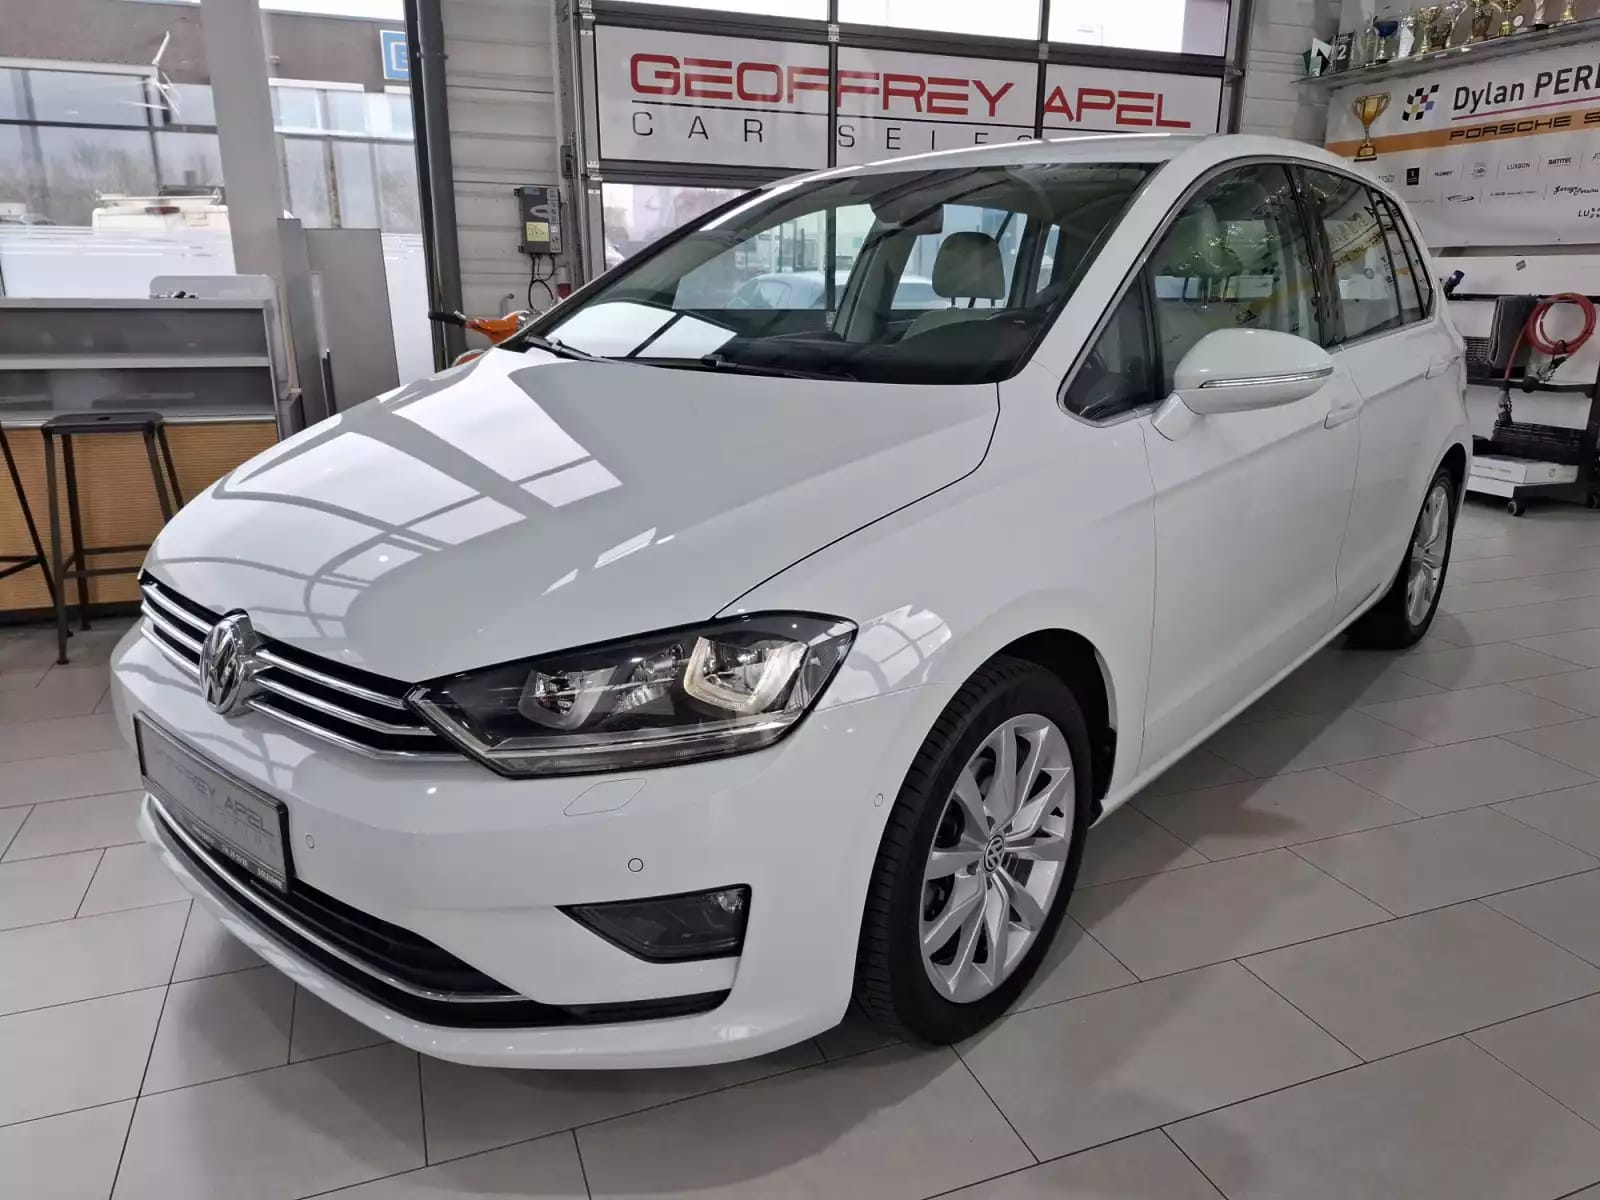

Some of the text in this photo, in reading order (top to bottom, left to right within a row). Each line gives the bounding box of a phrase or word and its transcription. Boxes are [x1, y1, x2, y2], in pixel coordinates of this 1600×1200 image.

[631, 53, 1191, 129] GEOFFREY APEL
[1453, 81, 1525, 114] Dylan
[632, 111, 763, 142] CAR
[1449, 115, 1572, 141] PORSCHE
